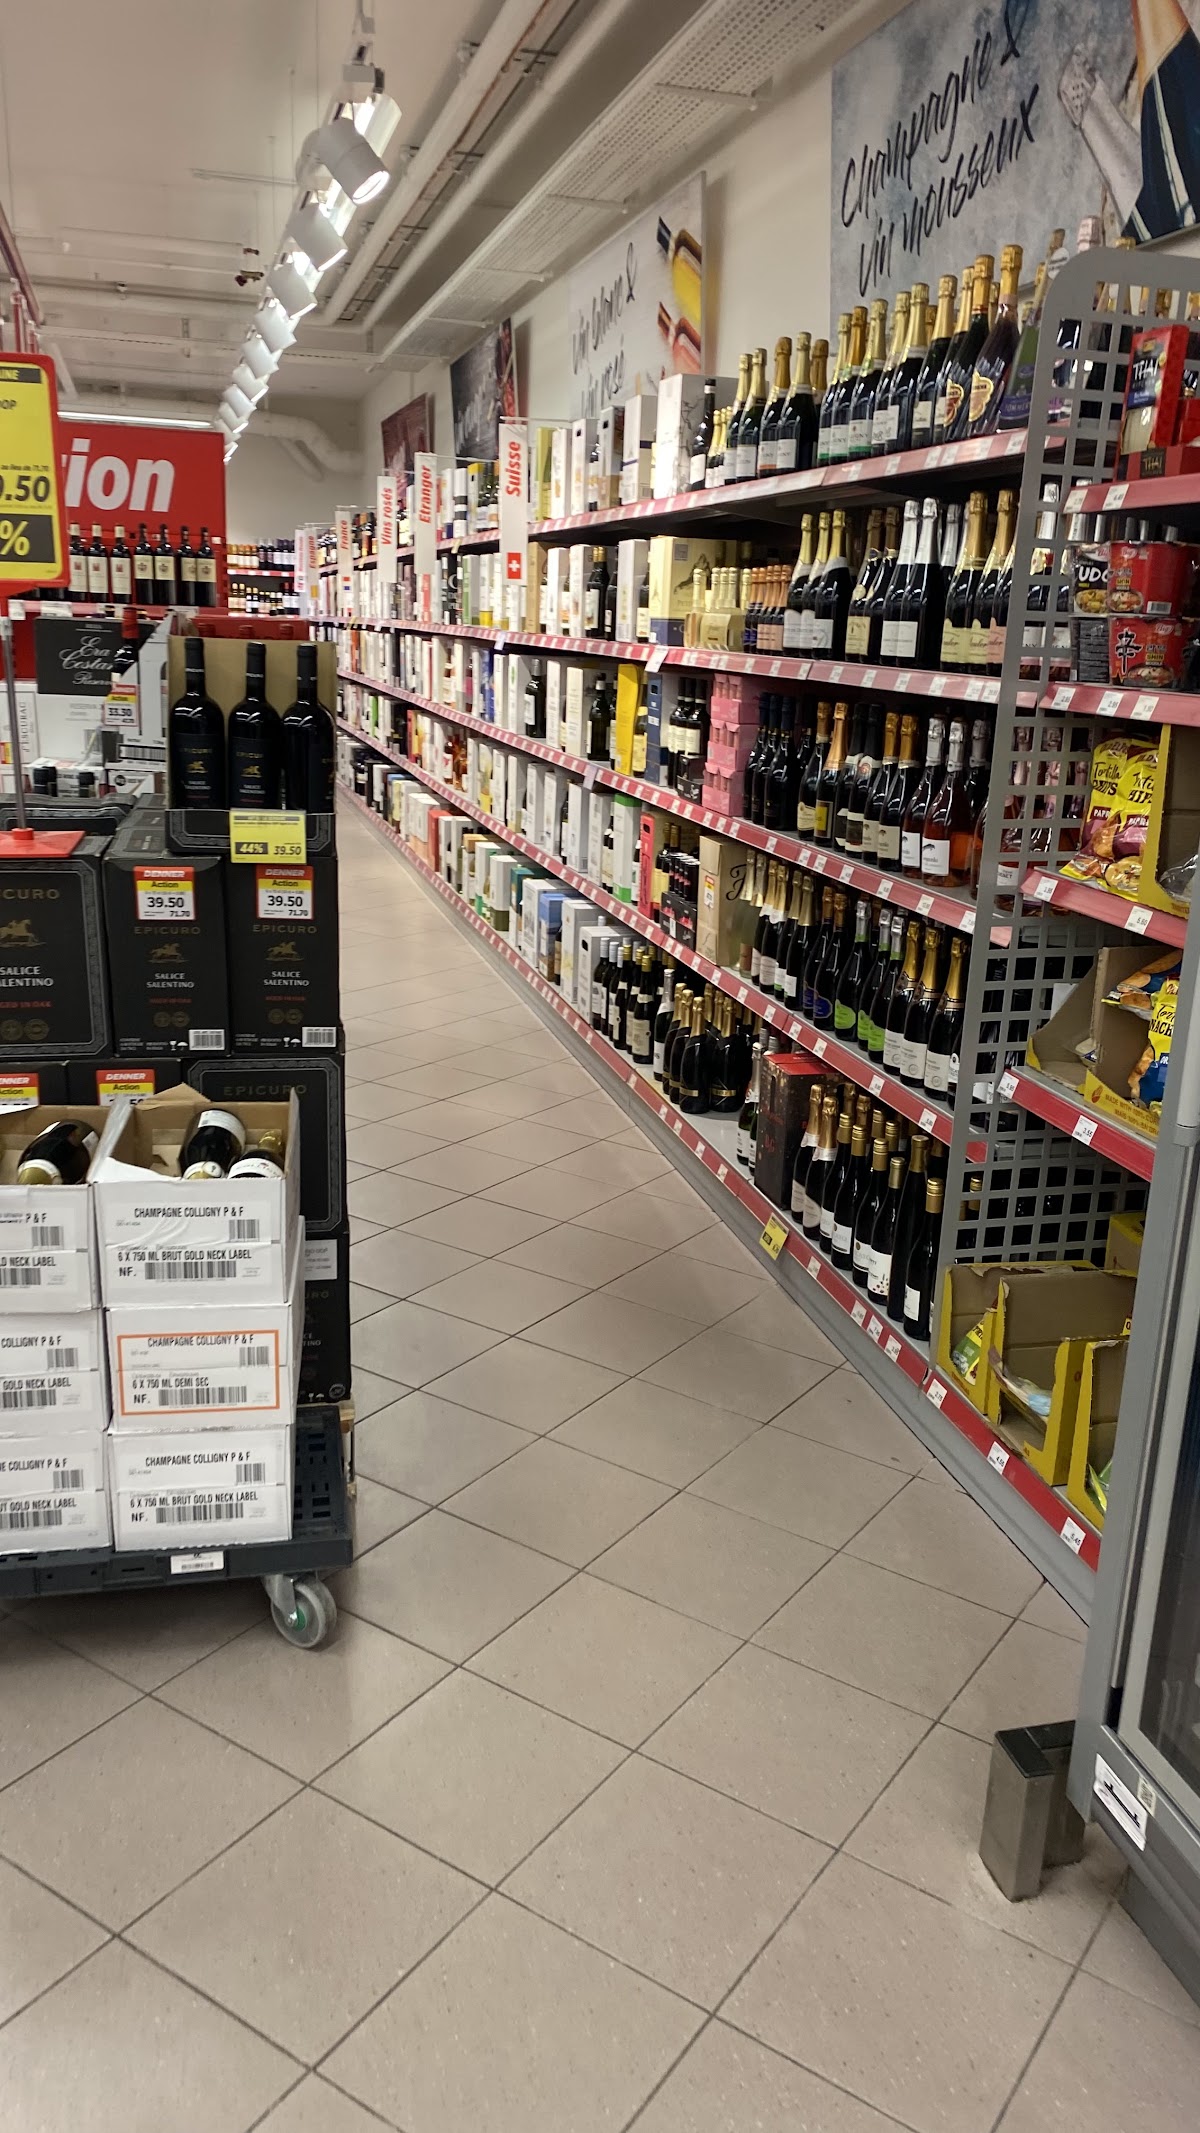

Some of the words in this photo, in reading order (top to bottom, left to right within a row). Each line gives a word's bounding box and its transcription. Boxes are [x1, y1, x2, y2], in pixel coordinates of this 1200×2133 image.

[842, 31, 992, 228] Champagne
[903, 83, 1040, 256] mousseux
[1133, 357, 1159, 380] THAI
[505, 441, 521, 497] Suisse
[418, 465, 432, 524] Etranger
[381, 487, 393, 519] rosés
[340, 519, 349, 550] France
[381, 521, 393, 545] Vins
[239, 843, 264, 854] 44%
[273, 845, 302, 856] 39.50
[265, 868, 305, 877] DENNER
[151, 881, 179, 889] Action
[271, 879, 299, 888] Action
[147, 897, 184, 909] 39.50
[267, 895, 303, 907] 39.50
[169, 910, 191, 918] 71.70
[288, 909, 309, 917] 71.70
[134, 926, 201, 936] EPICURO
[252, 924, 318, 935] EPICURO
[155, 972, 186, 981] SALICE
[271, 971, 301, 979] SALICE
[146, 981, 195, 989] SALENTINO
[263, 979, 310, 987] SALENTINO
[105, 1073, 146, 1081] DENNER
[112, 1083, 140, 1091] Action
[25, 1212, 31, 1224] P
[33, 1213, 39, 1223] &
[41, 1212, 48, 1223] F
[134, 1207, 182, 1218] CHAMPAGNE
[184, 1206, 221, 1218] COLLIGNY
[223, 1207, 229, 1217] P
[231, 1206, 237, 1217] &
[239, 1206, 244, 1217] F
[9, 1256, 30, 1267] NECK
[32, 1256, 56, 1267] LABEL
[117, 1251, 122, 1262] 6
[124, 1251, 131, 1261] X
[132, 1251, 146, 1261] 750
[148, 1251, 159, 1261] ML
[161, 1250, 182, 1261] BRUT
[184, 1250, 205, 1260] GOLD
[207, 1249, 226, 1260] NECK
[228, 1249, 252, 1260] LABEL
[118, 1266, 137, 1277] NF.
[1, 1336, 39, 1349] COLLIGNY
[41, 1336, 46, 1346] P
[48, 1336, 55, 1346] &
[56, 1335, 62, 1346] F
[147, 1336, 194, 1348] CHAMPAGNE
[196, 1335, 232, 1346] COLLIGNY
[234, 1334, 239, 1345] P
[241, 1335, 247, 1344] &
[249, 1334, 254, 1344] F
[3, 1380, 23, 1391] GOLD
[25, 1378, 46, 1389] NECK
[47, 1377, 72, 1389] LABEL
[132, 1379, 137, 1389] 6
[139, 1379, 145, 1389] X
[147, 1379, 159, 1389] 750
[161, 1378, 173, 1388] ML
[174, 1377, 193, 1388] DEMI
[195, 1377, 209, 1387] SEC
[133, 1393, 151, 1404] NF.
[9, 1459, 46, 1471] COLLIGNY
[47, 1458, 53, 1469] P
[54, 1458, 61, 1468] &
[62, 1457, 68, 1468] F
[145, 1454, 192, 1467] CHAMPAGNE
[193, 1452, 229, 1464] COLLIGNY
[230, 1452, 236, 1462] P
[238, 1452, 244, 1461] &
[245, 1451, 251, 1461] F
[9, 1500, 30, 1512] GOLD
[32, 1499, 52, 1510] NECK
[53, 1497, 78, 1509] LABEL
[130, 1499, 135, 1508] 6
[137, 1498, 143, 1508] X
[144, 1497, 157, 1507] 750
[158, 1497, 170, 1506] ML
[172, 1495, 192, 1506] BRUT
[193, 1494, 213, 1504] GOLD
[215, 1493, 234, 1503] NECK
[235, 1491, 258, 1502] LABEL
[131, 1512, 148, 1522] NF.
